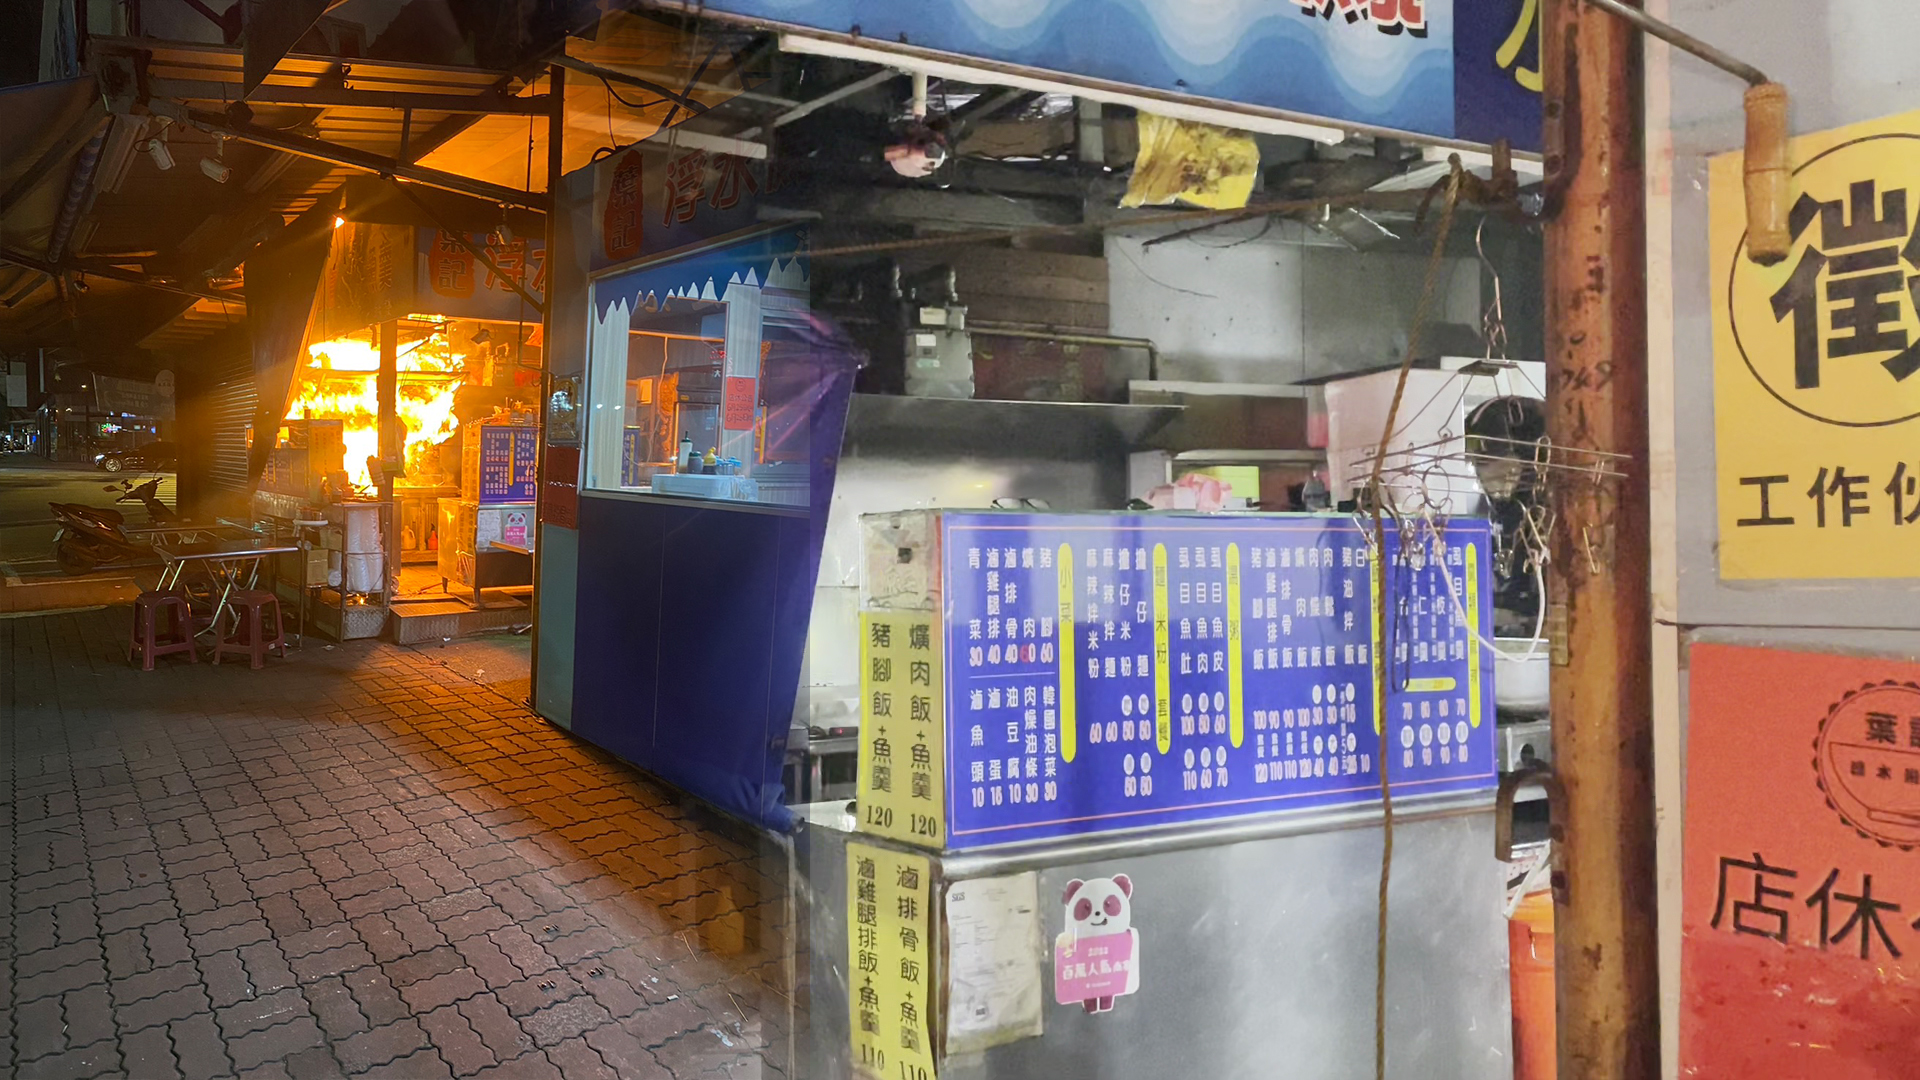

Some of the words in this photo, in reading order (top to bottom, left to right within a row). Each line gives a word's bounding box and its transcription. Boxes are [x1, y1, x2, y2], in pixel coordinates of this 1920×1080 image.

[968, 547, 982, 640] 青菜
[987, 644, 1001, 664] 40
[1005, 643, 1018, 664] 40
[1183, 769, 1198, 791] 110
[971, 786, 985, 808] 10
[1008, 783, 1022, 804] 10
[866, 805, 893, 829] 120
[909, 813, 937, 839] 120
[1710, 852, 1920, 960] 店休
[861, 1043, 885, 1072] 110
[899, 1060, 927, 1080] 110
